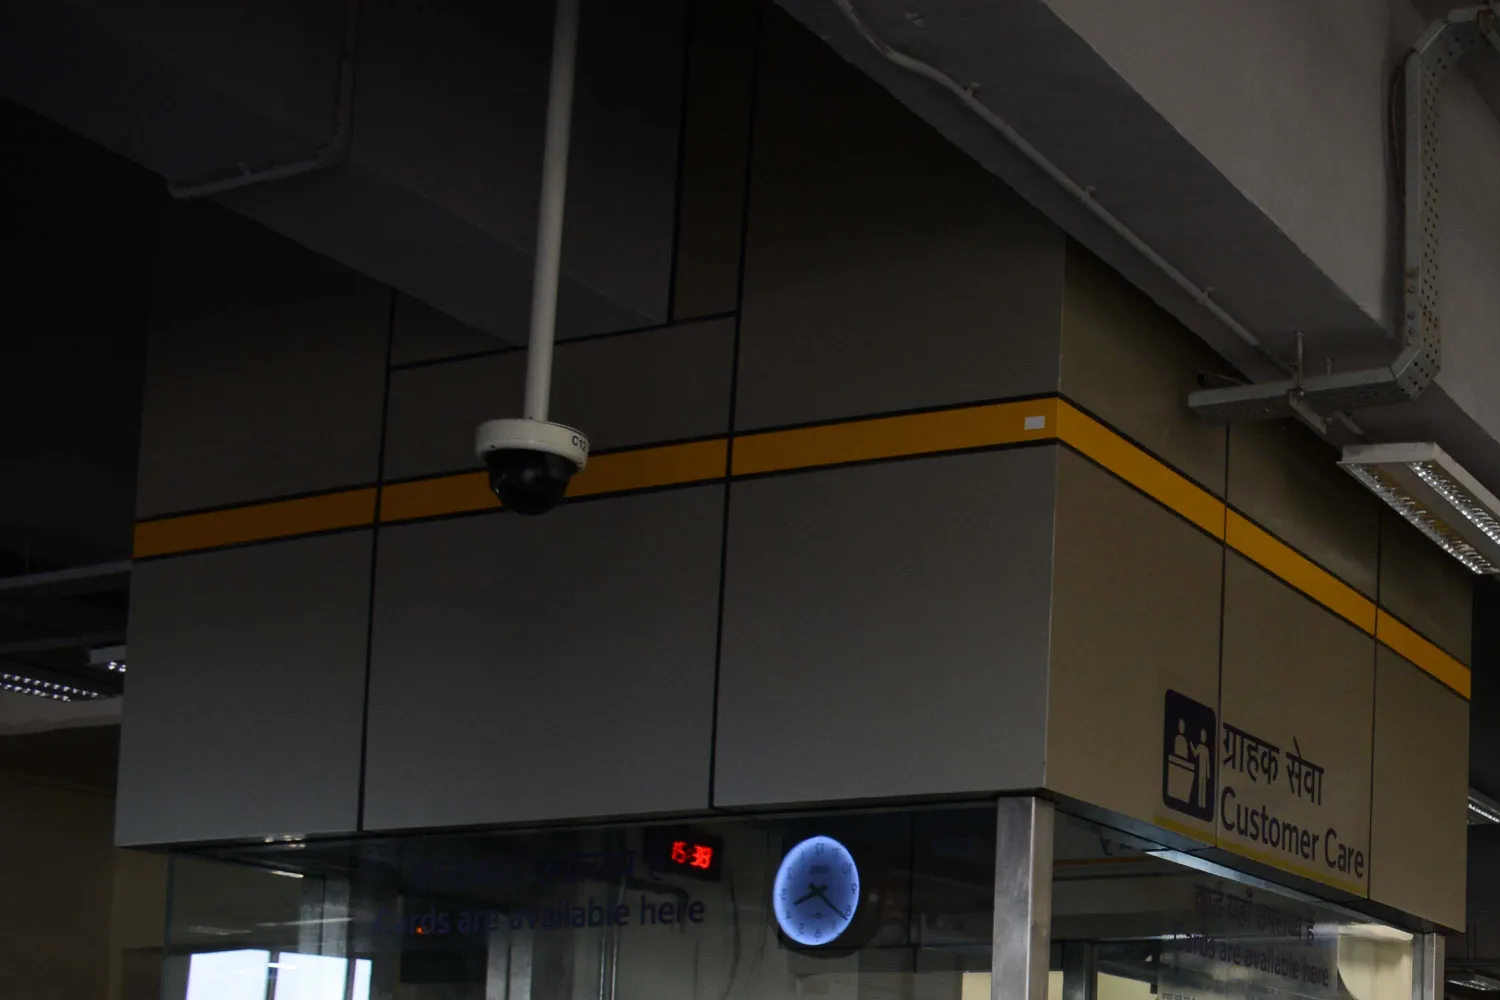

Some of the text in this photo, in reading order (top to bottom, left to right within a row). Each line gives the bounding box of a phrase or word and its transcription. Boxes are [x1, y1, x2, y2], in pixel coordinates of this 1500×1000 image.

[1222, 722, 1325, 805] ग्राहक सेवा
[1220, 786, 1365, 879] Customer Care
[640, 894, 705, 926] here
